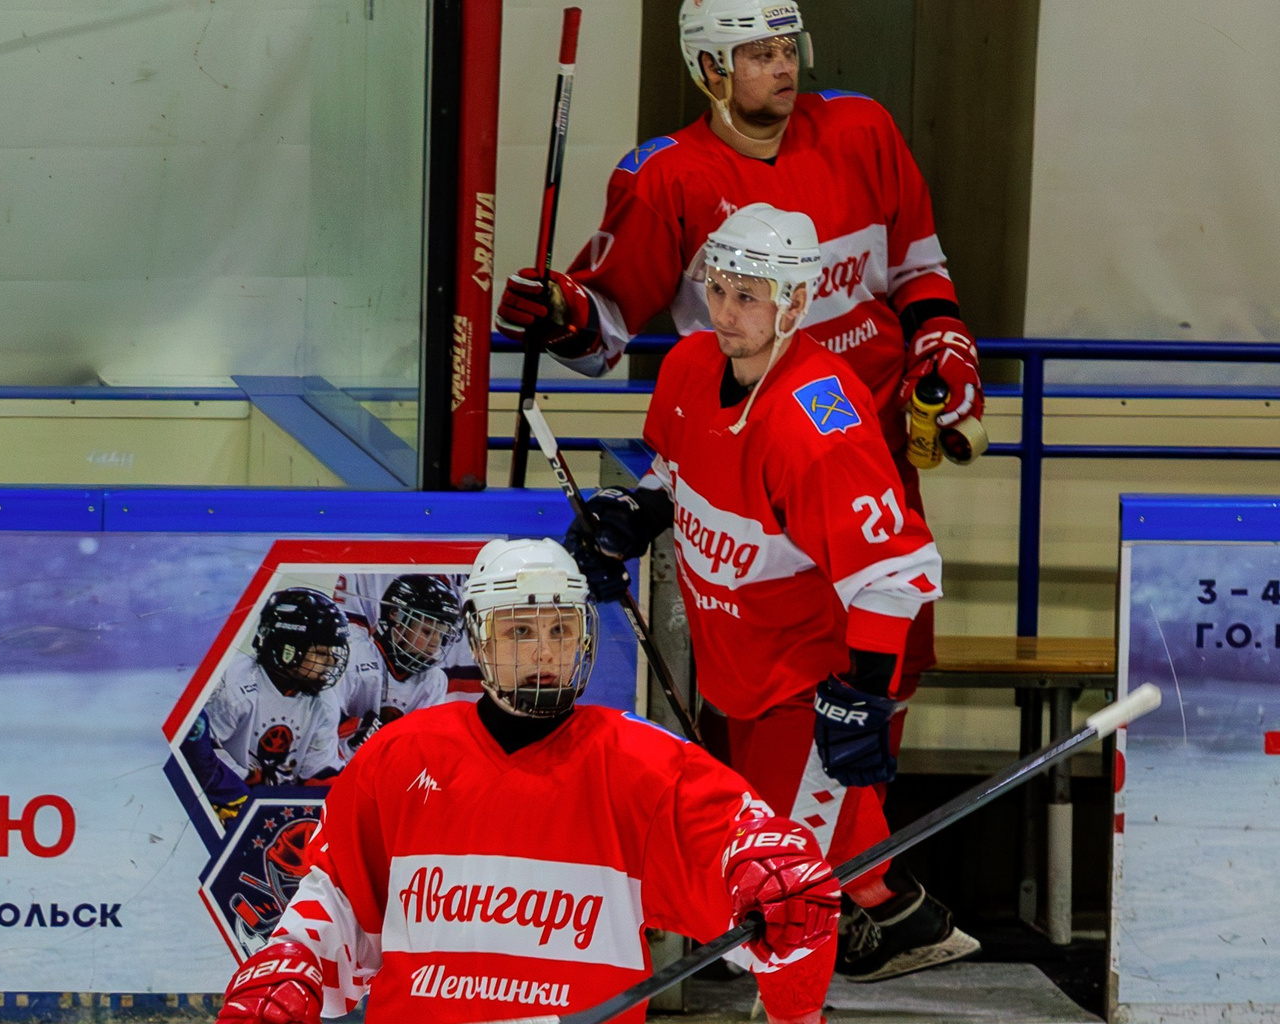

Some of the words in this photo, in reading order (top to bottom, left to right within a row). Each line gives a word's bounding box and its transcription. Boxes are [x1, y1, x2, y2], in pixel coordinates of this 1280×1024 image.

[474, 192, 495, 266] RAITA
[915, 331, 978, 362] CC
[852, 487, 904, 544] 21
[1197, 579, 1217, 605] 3
[1196, 623, 1261, 649] Г.О.
[814, 693, 869, 726] UER
[400, 866, 604, 950] Авангард
[410, 964, 570, 1007] Шепчинки
